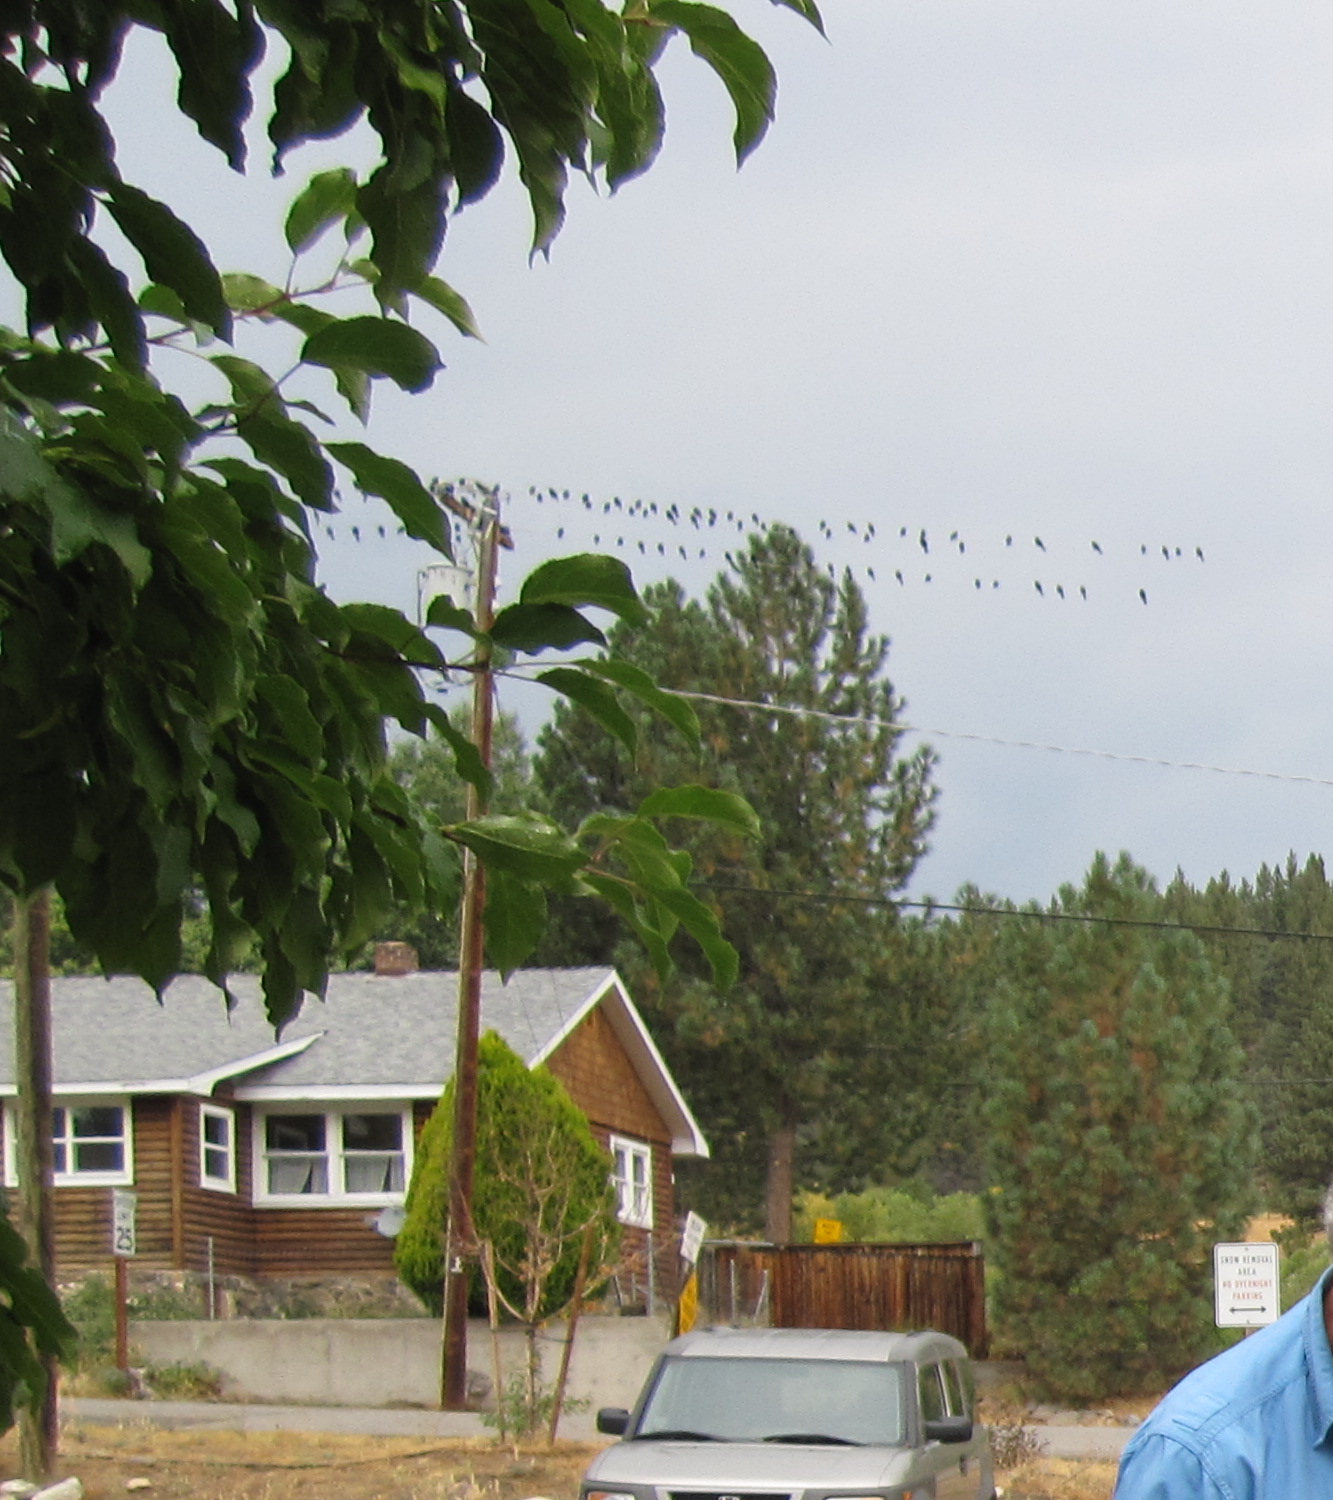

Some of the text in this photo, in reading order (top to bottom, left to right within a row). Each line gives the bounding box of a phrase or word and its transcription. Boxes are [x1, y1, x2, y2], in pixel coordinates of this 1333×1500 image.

[117, 1226, 132, 1251] 25
[1221, 1255, 1273, 1264] SNOW REMOVAL
[1238, 1268, 1257, 1276] AREA
[1222, 1280, 1272, 1288] NO OVERNIGHT
[1232, 1292, 1263, 1300] PARKING
